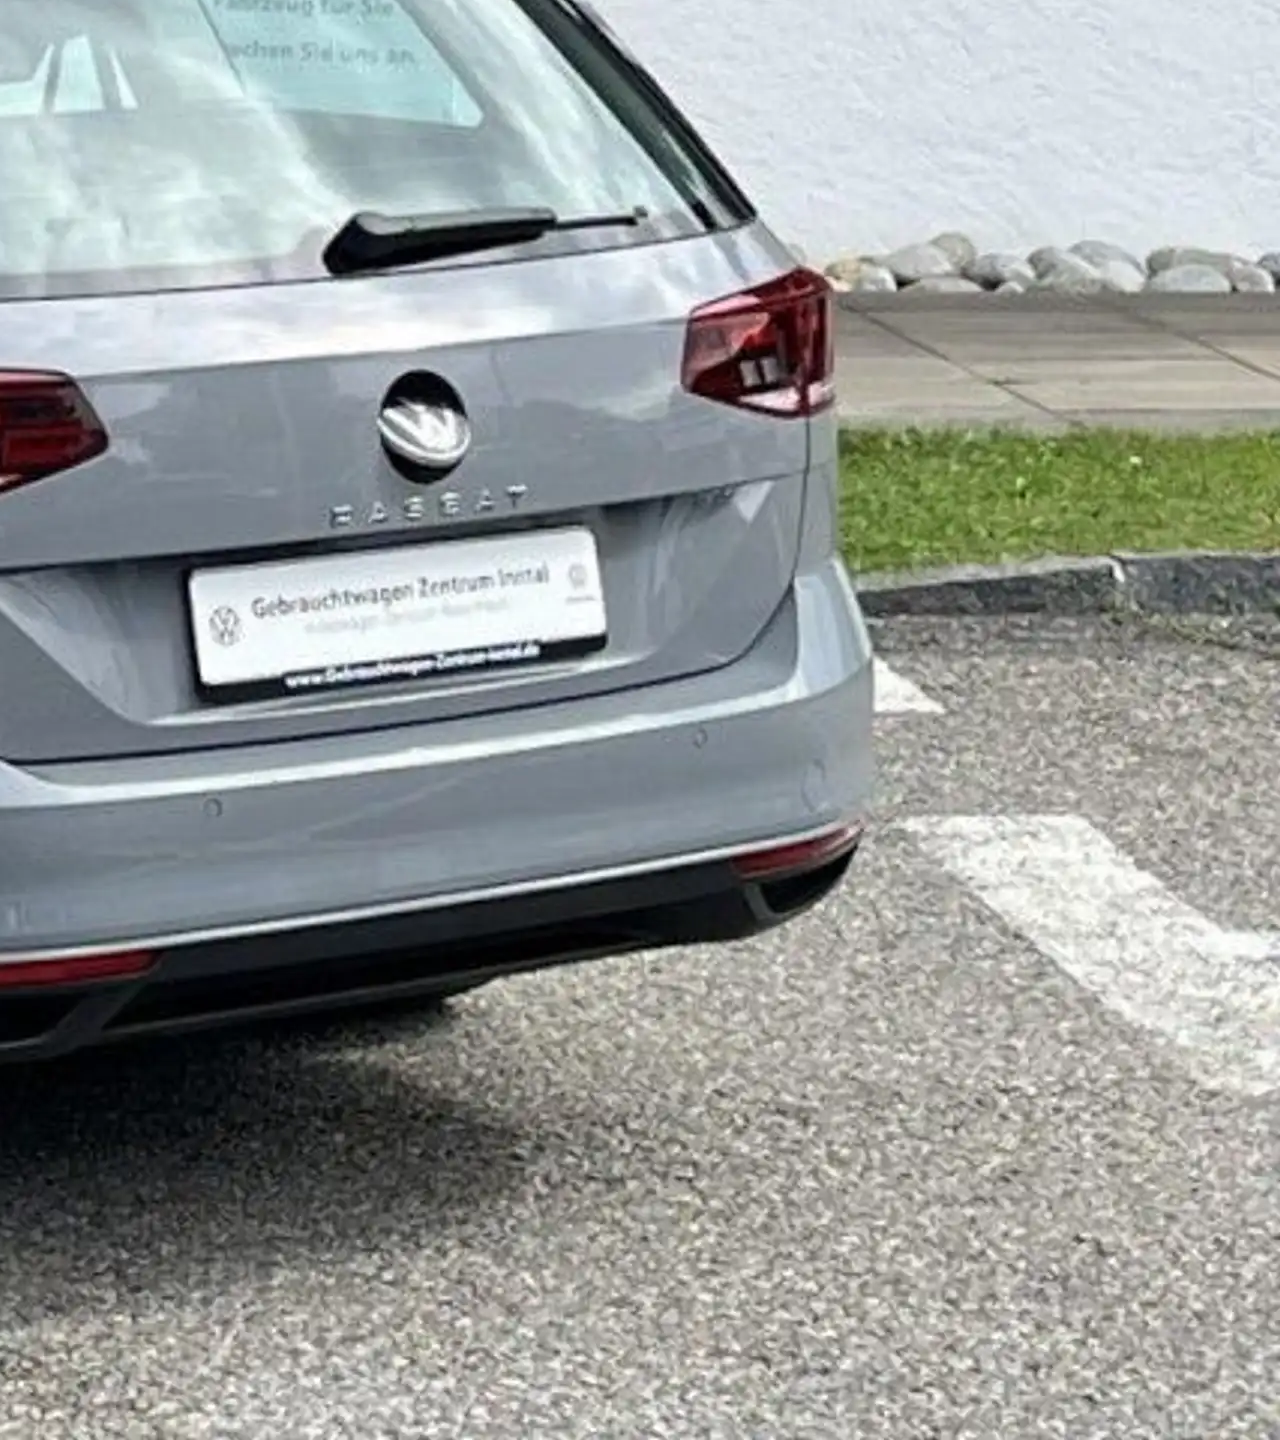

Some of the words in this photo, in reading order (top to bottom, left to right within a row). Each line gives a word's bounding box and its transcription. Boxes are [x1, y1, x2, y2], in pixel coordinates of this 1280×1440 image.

[328, 483, 529, 529] PASSAT
[251, 581, 415, 620] Gebrauchtwagen
[416, 574, 496, 599] Zentrum
[497, 561, 551, 588] Inntal
